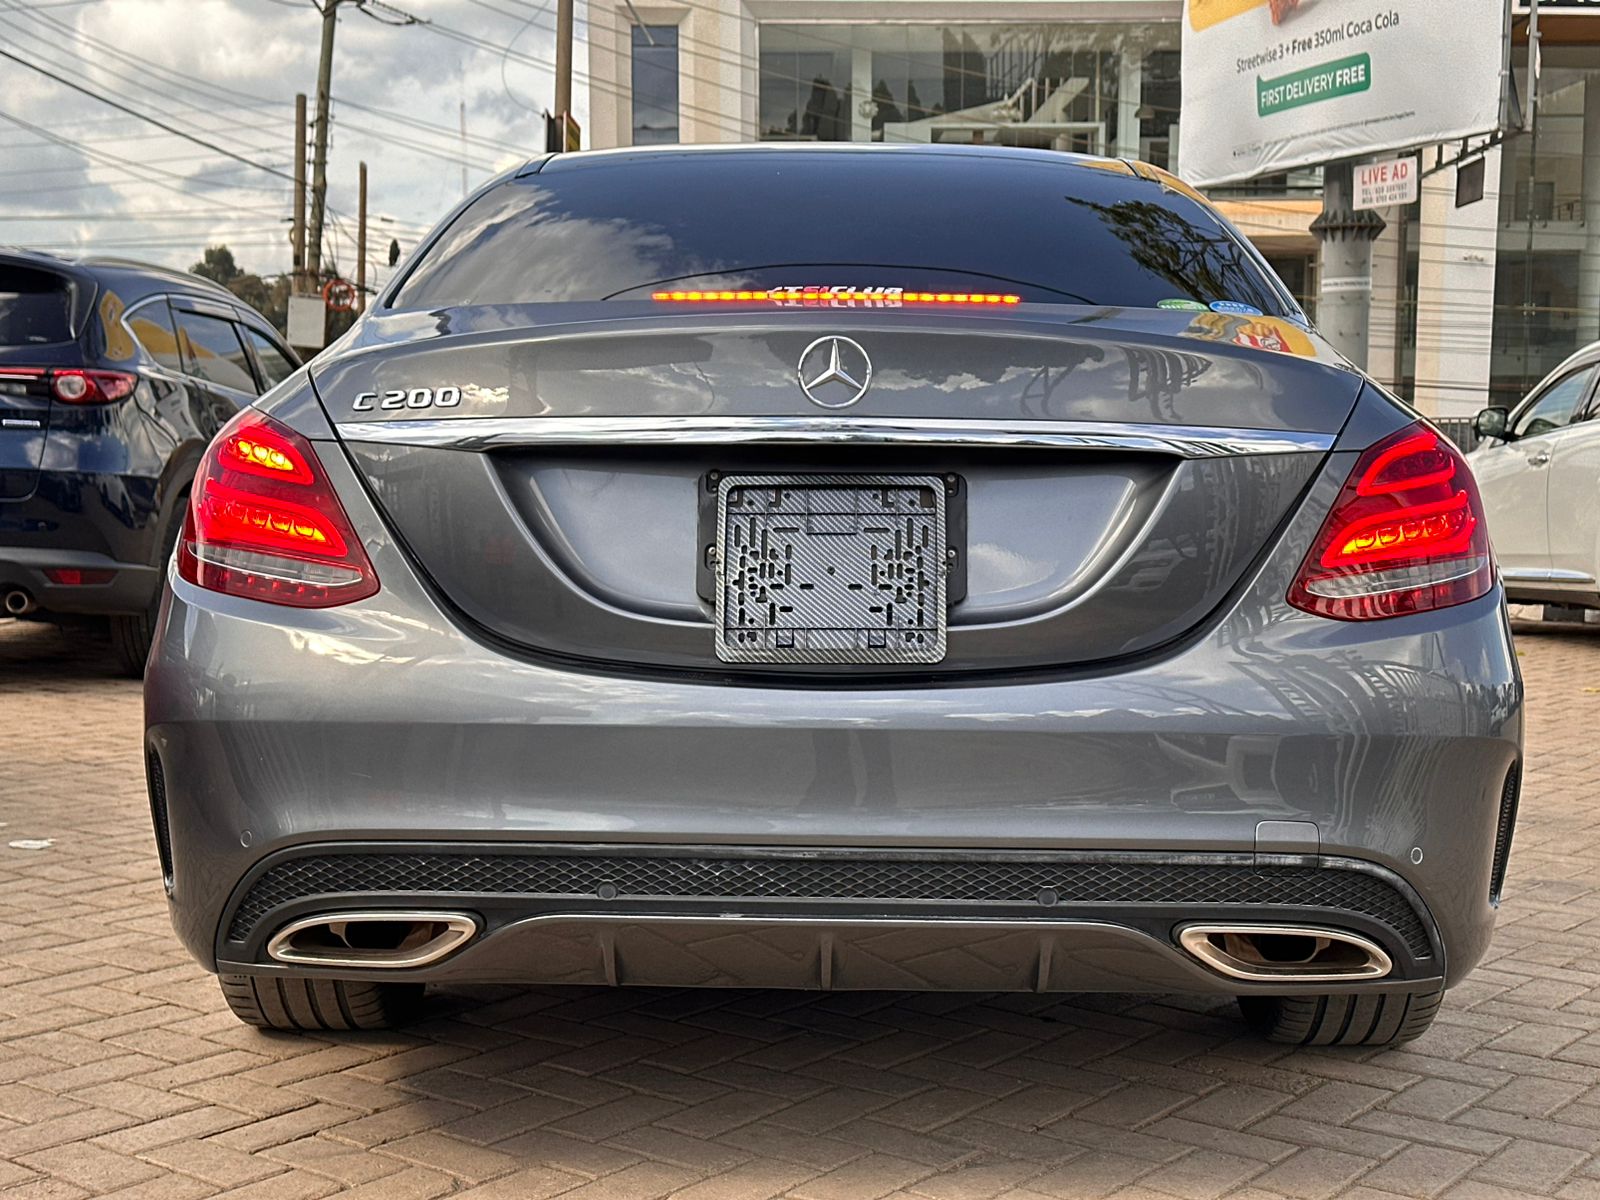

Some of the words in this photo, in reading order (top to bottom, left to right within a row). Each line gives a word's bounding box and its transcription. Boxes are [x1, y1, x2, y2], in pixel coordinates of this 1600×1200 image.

[1236, 46, 1277, 73] Streetwise
[1278, 43, 1284, 59] 3
[1292, 38, 1313, 56] Free
[1314, 24, 1345, 48] 350ml
[1346, 20, 1373, 38] Coca
[1374, 9, 1400, 30] Cola
[1261, 85, 1285, 108] FIRST
[1286, 72, 1335, 101] DELIVERY
[1335, 64, 1366, 88] FREE
[1361, 165, 1388, 186] LIVE
[1391, 162, 1408, 181] AD
[352, 392, 377, 412] C
[380, 386, 462, 411] 200
